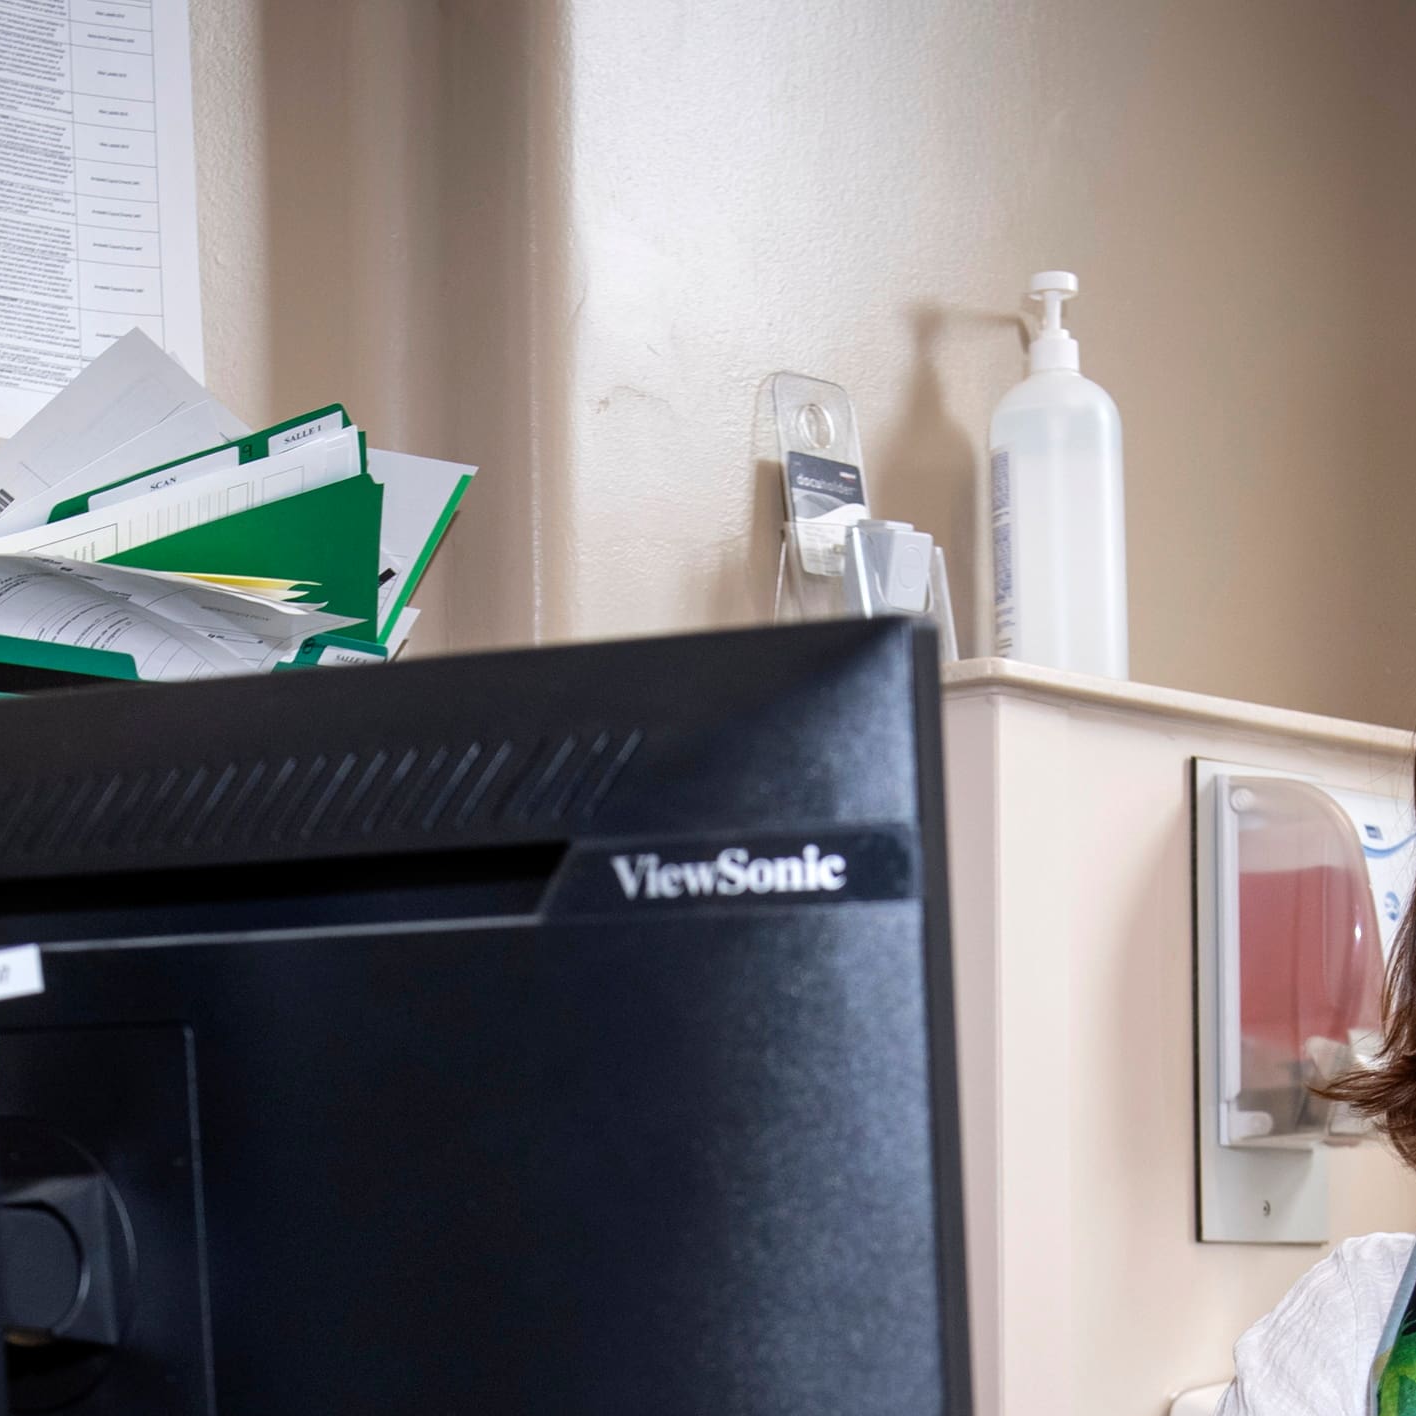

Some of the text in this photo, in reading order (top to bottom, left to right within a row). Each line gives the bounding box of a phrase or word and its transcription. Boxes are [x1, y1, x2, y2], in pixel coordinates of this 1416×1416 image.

[283, 428, 316, 444] SALLE
[150, 475, 177, 491] SCAN
[610, 843, 847, 900] ViewSonic
